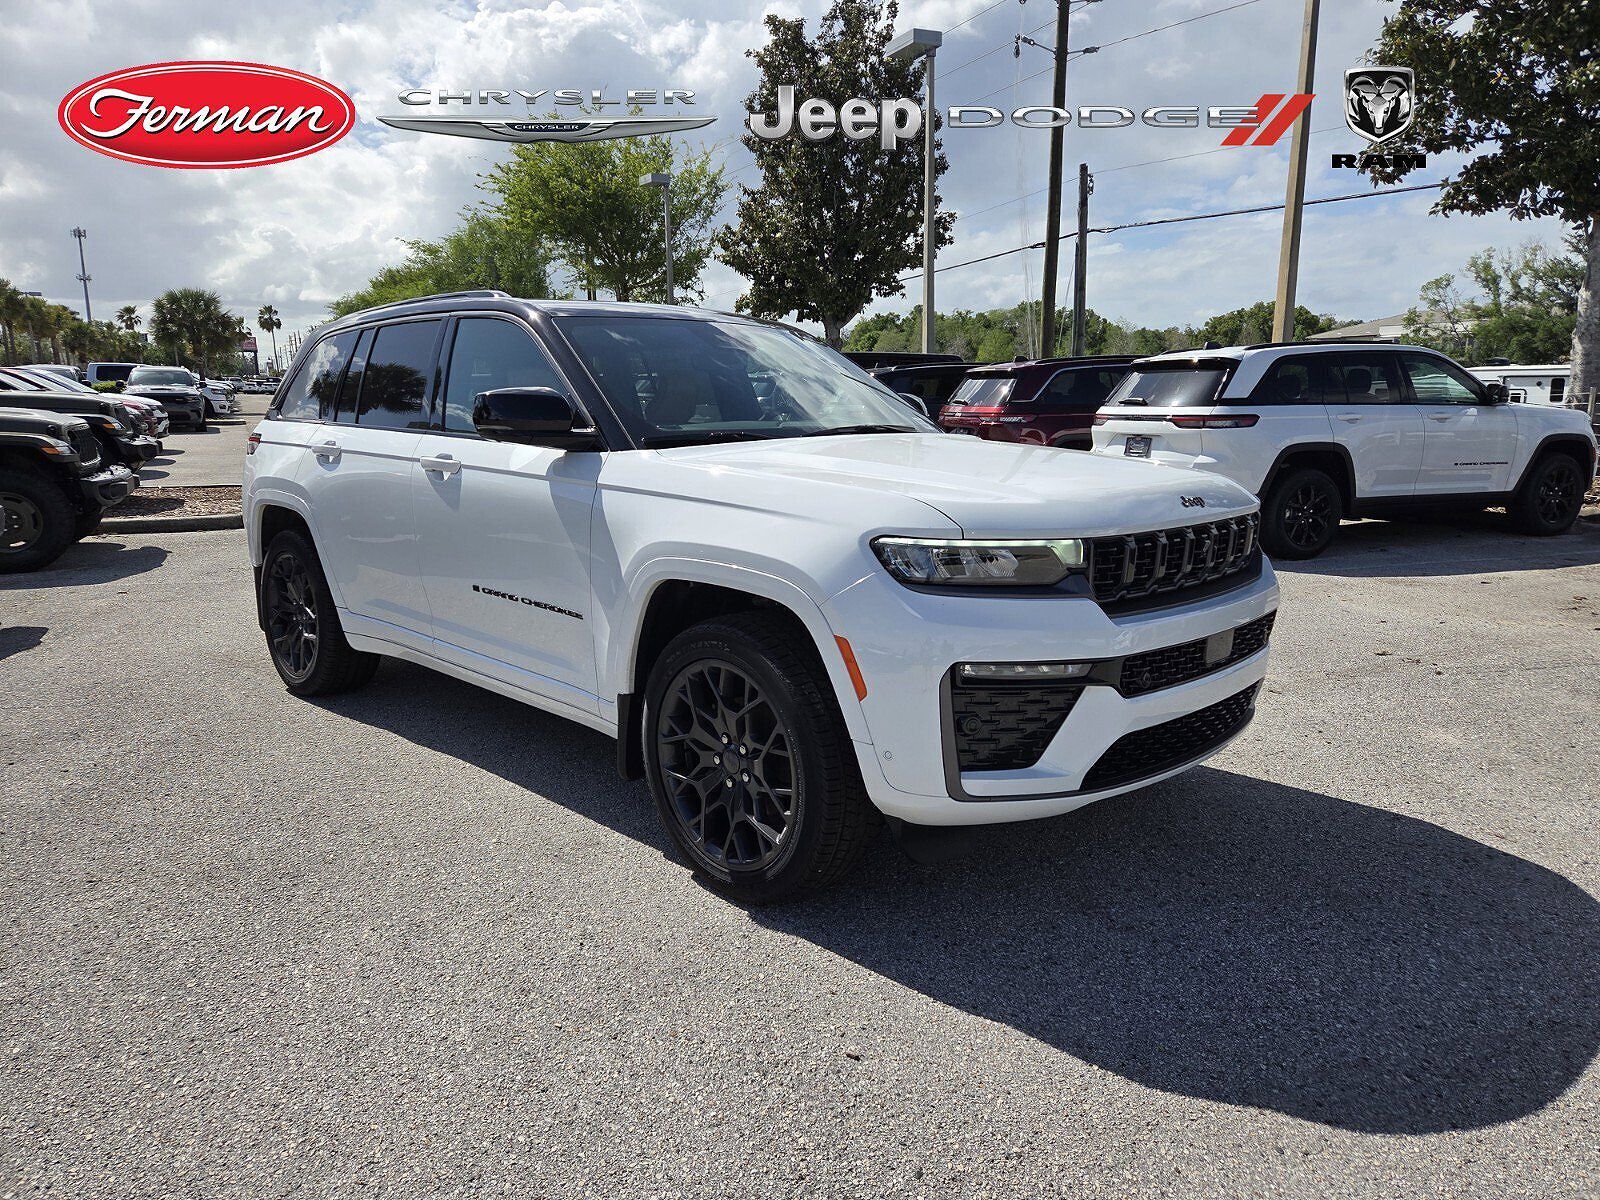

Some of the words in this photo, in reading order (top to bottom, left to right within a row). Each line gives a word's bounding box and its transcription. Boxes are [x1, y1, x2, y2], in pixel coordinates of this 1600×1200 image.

[1180, 495, 1206, 508] Jeep
[481, 587, 519, 602] GRAND
[520, 597, 584, 620] CHEROKEE
